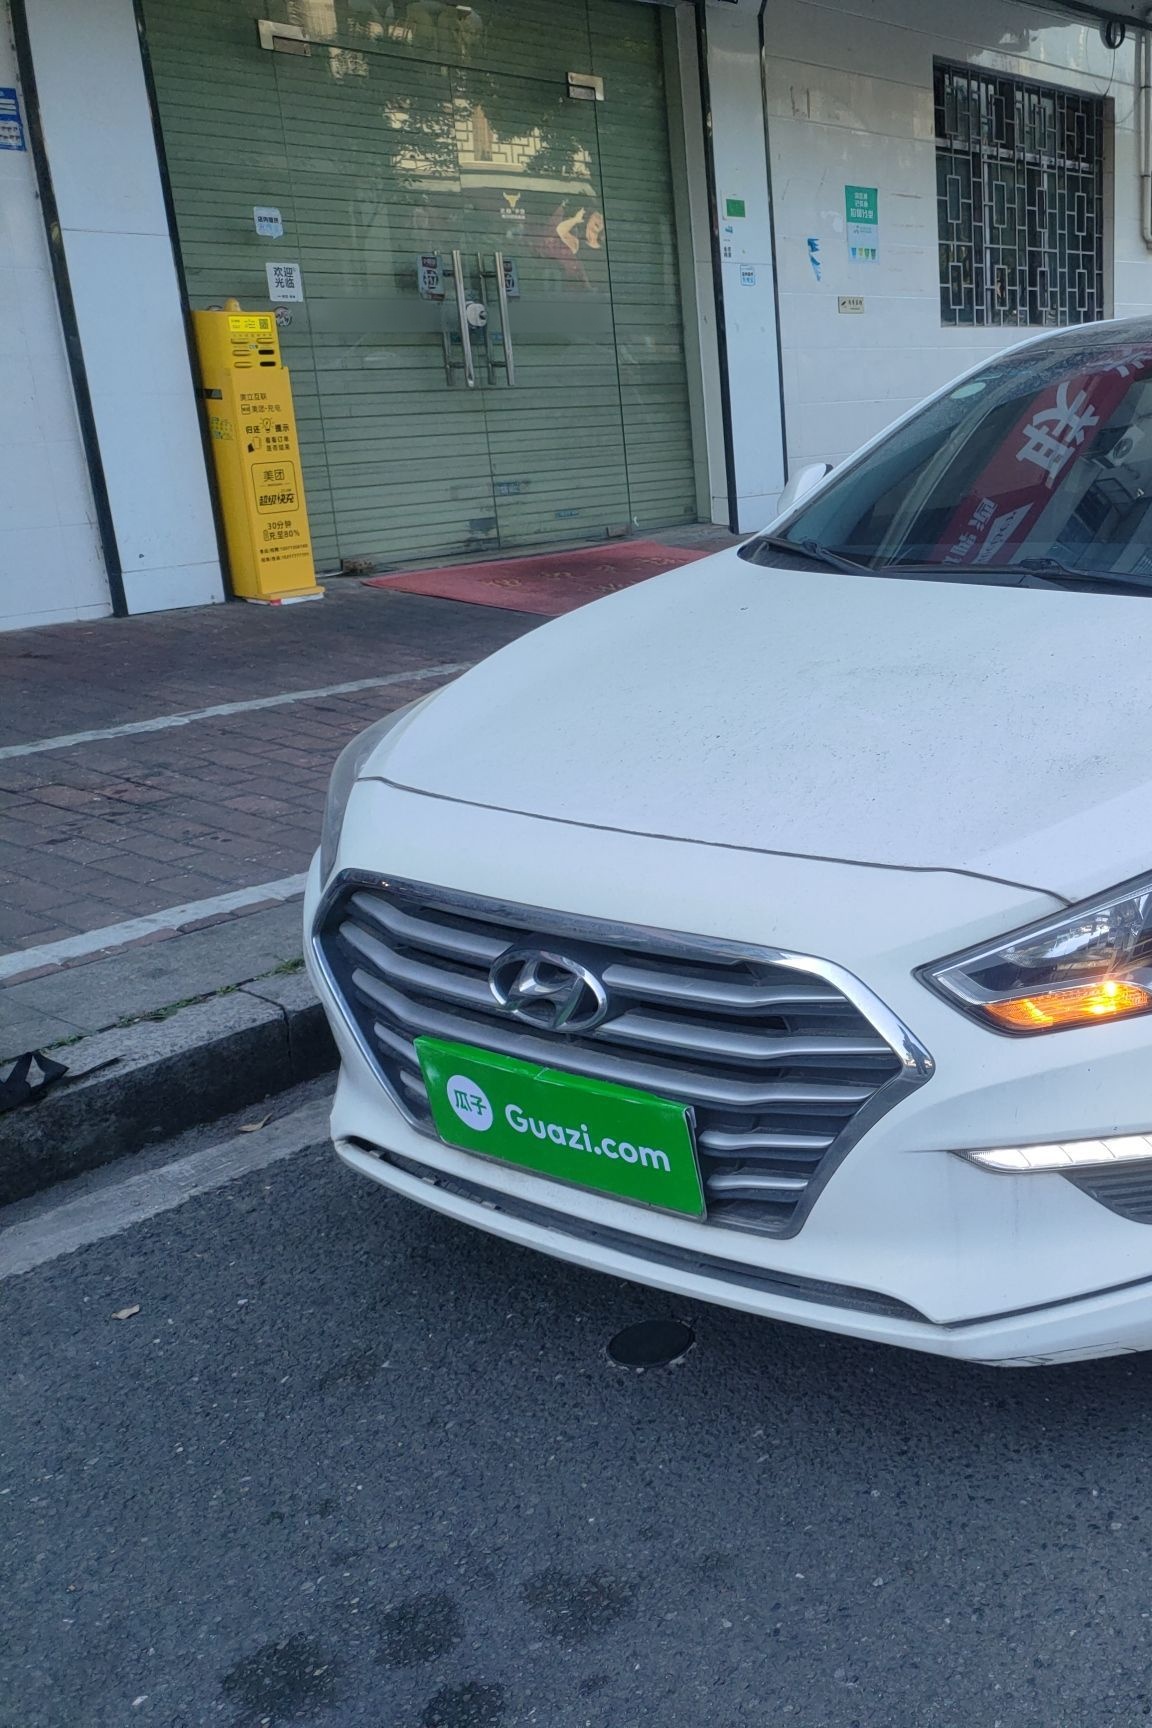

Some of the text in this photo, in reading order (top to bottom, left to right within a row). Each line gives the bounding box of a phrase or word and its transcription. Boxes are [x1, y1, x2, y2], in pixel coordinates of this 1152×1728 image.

[273, 266, 294, 278] 欢迎
[275, 278, 295, 289] 光临
[263, 469, 285, 482] 美团
[267, 520, 291, 530] 30分钟
[454, 1089, 487, 1116] 瓜子
[505, 1104, 671, 1172] Guazi.com
